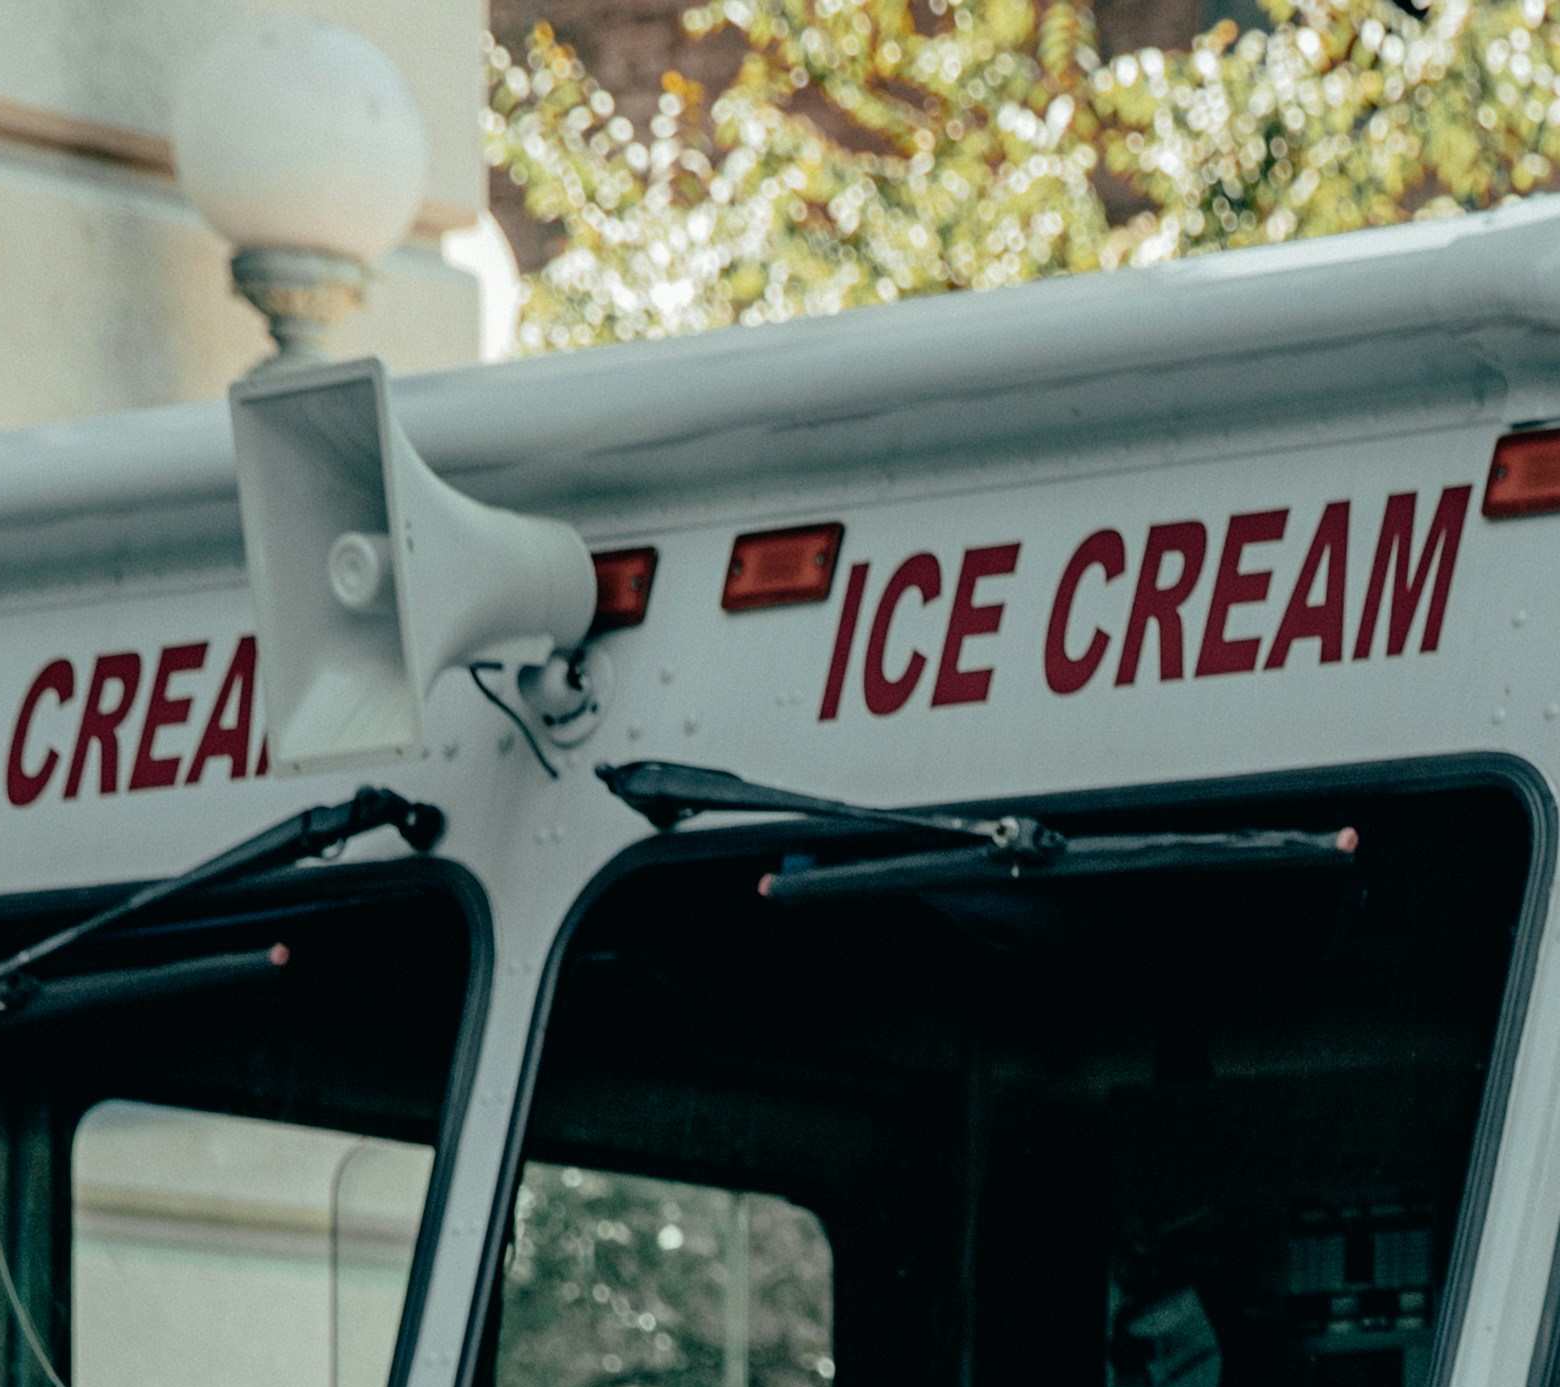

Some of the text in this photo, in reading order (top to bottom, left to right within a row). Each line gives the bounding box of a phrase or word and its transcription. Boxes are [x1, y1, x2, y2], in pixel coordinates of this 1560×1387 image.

[818, 484, 1473, 722] ICE CREAM
[6, 635, 271, 807] CREA
